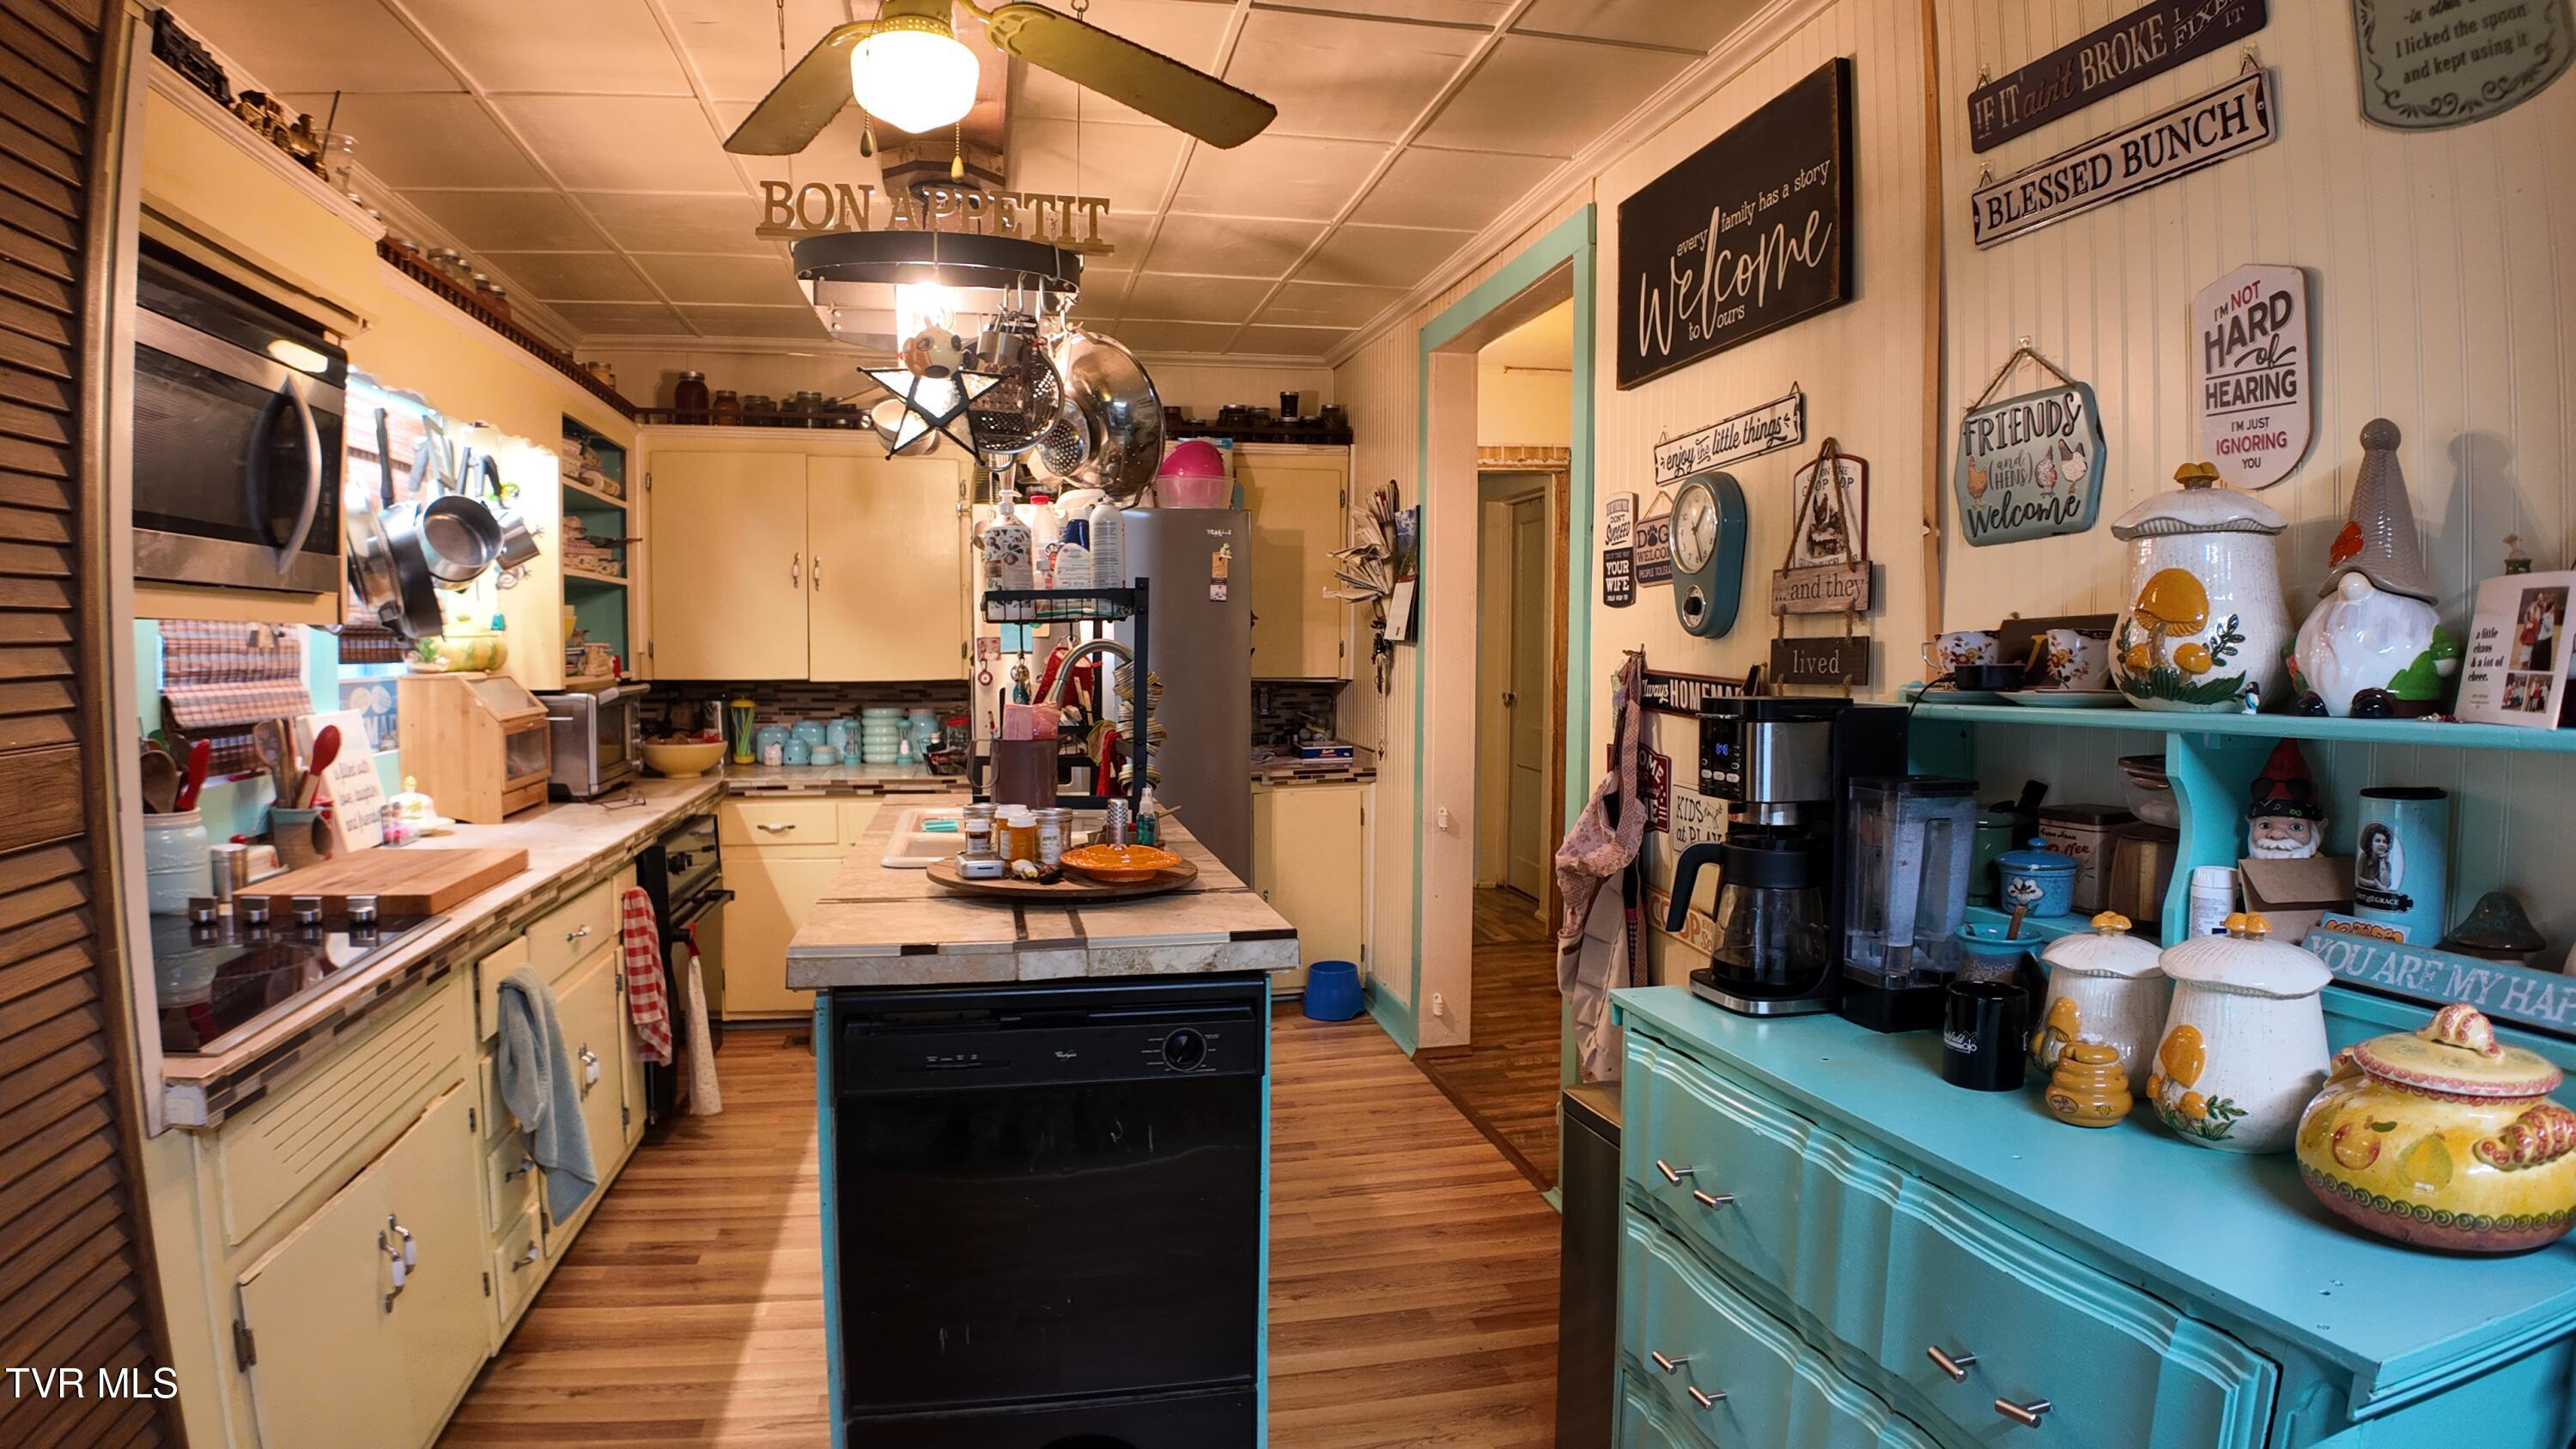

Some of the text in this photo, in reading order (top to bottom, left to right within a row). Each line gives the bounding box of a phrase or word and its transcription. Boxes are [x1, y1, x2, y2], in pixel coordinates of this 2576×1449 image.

[2226, 5, 2245, 28] IT
[2396, 41, 2402, 59] I
[2405, 28, 2450, 56] licked
[2454, 19, 2478, 39] the
[2482, 3, 2527, 31] spoon
[1974, 97, 1995, 140] IF
[1999, 84, 2020, 128] IT
[2079, 12, 2168, 92] BROKE
[2403, 32, 2529, 84] and kept using it
[1985, 93, 2250, 230] BLESSED BUNCH
[759, 180, 1111, 245] BON APPETIT
[1676, 159, 1831, 257] every family has a story
[1639, 206, 1832, 356] Welcome
[2215, 280, 2261, 322] I'M NOT
[1688, 304, 1745, 342] to ours
[2205, 290, 2293, 374] HARD
[2234, 333, 2297, 369] of
[2206, 369, 2297, 410] HEARING
[1964, 393, 2081, 457] FRIENDS
[2216, 431, 2287, 456] IGNORING
[2232, 417, 2269, 432] I'M JUST
[1667, 417, 1785, 478] enjoy the little things
[2242, 457, 2262, 470] YOU
[1967, 490, 2081, 538] Welcome
[1606, 560, 1630, 575] YOUR
[1606, 576, 1630, 592] WIFE
[1826, 573, 1865, 602] they
[1792, 648, 1840, 674] lived
[1676, 795, 1704, 823] KIDS
[1676, 826, 1687, 843] at
[2375, 897, 2400, 906] GRACE
[2312, 935, 2378, 977] YOU
[2371, 951, 2445, 993] ARE
[2444, 964, 2507, 1006] MY
